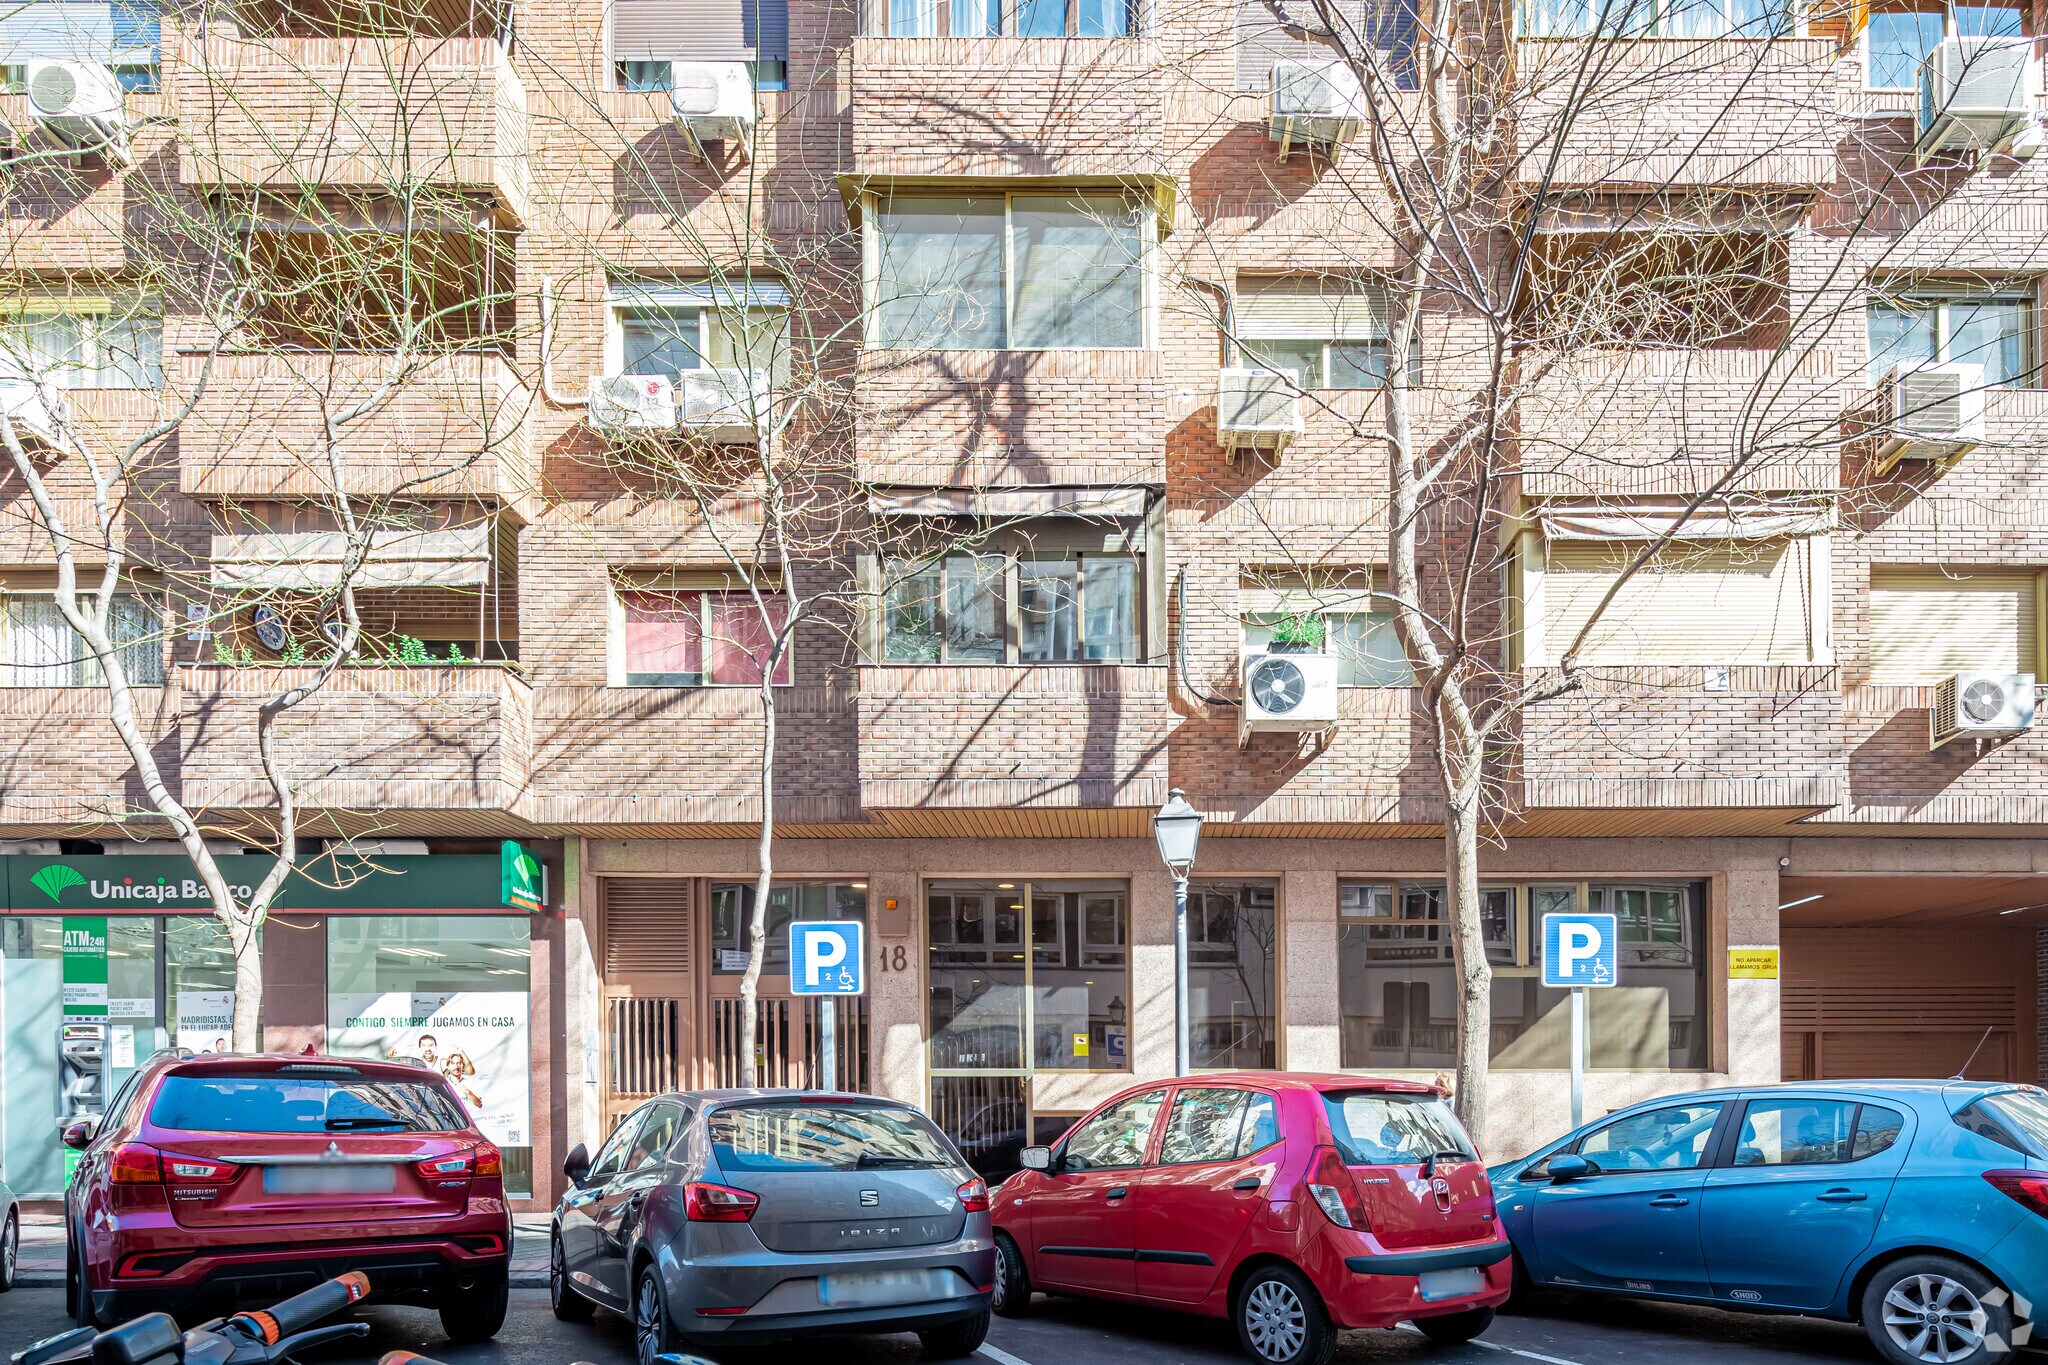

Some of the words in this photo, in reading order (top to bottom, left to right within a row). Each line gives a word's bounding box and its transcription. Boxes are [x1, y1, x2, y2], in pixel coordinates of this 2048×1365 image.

[91, 877, 178, 904] Unicaja
[182, 880, 252, 899] Baco
[64, 931, 89, 946] ATM
[90, 937, 105, 946] 24H
[805, 930, 847, 986] P
[880, 945, 907, 972] 18
[1559, 922, 1602, 977] P
[391, 1017, 429, 1027] SIEMPRE
[433, 1017, 475, 1027] JUGAMOS
[478, 1017, 489, 1027] EN
[492, 1017, 515, 1027] CASA
[841, 1227, 900, 1237] IBIZA
[1734, 1291, 1758, 1300] SHOEI
